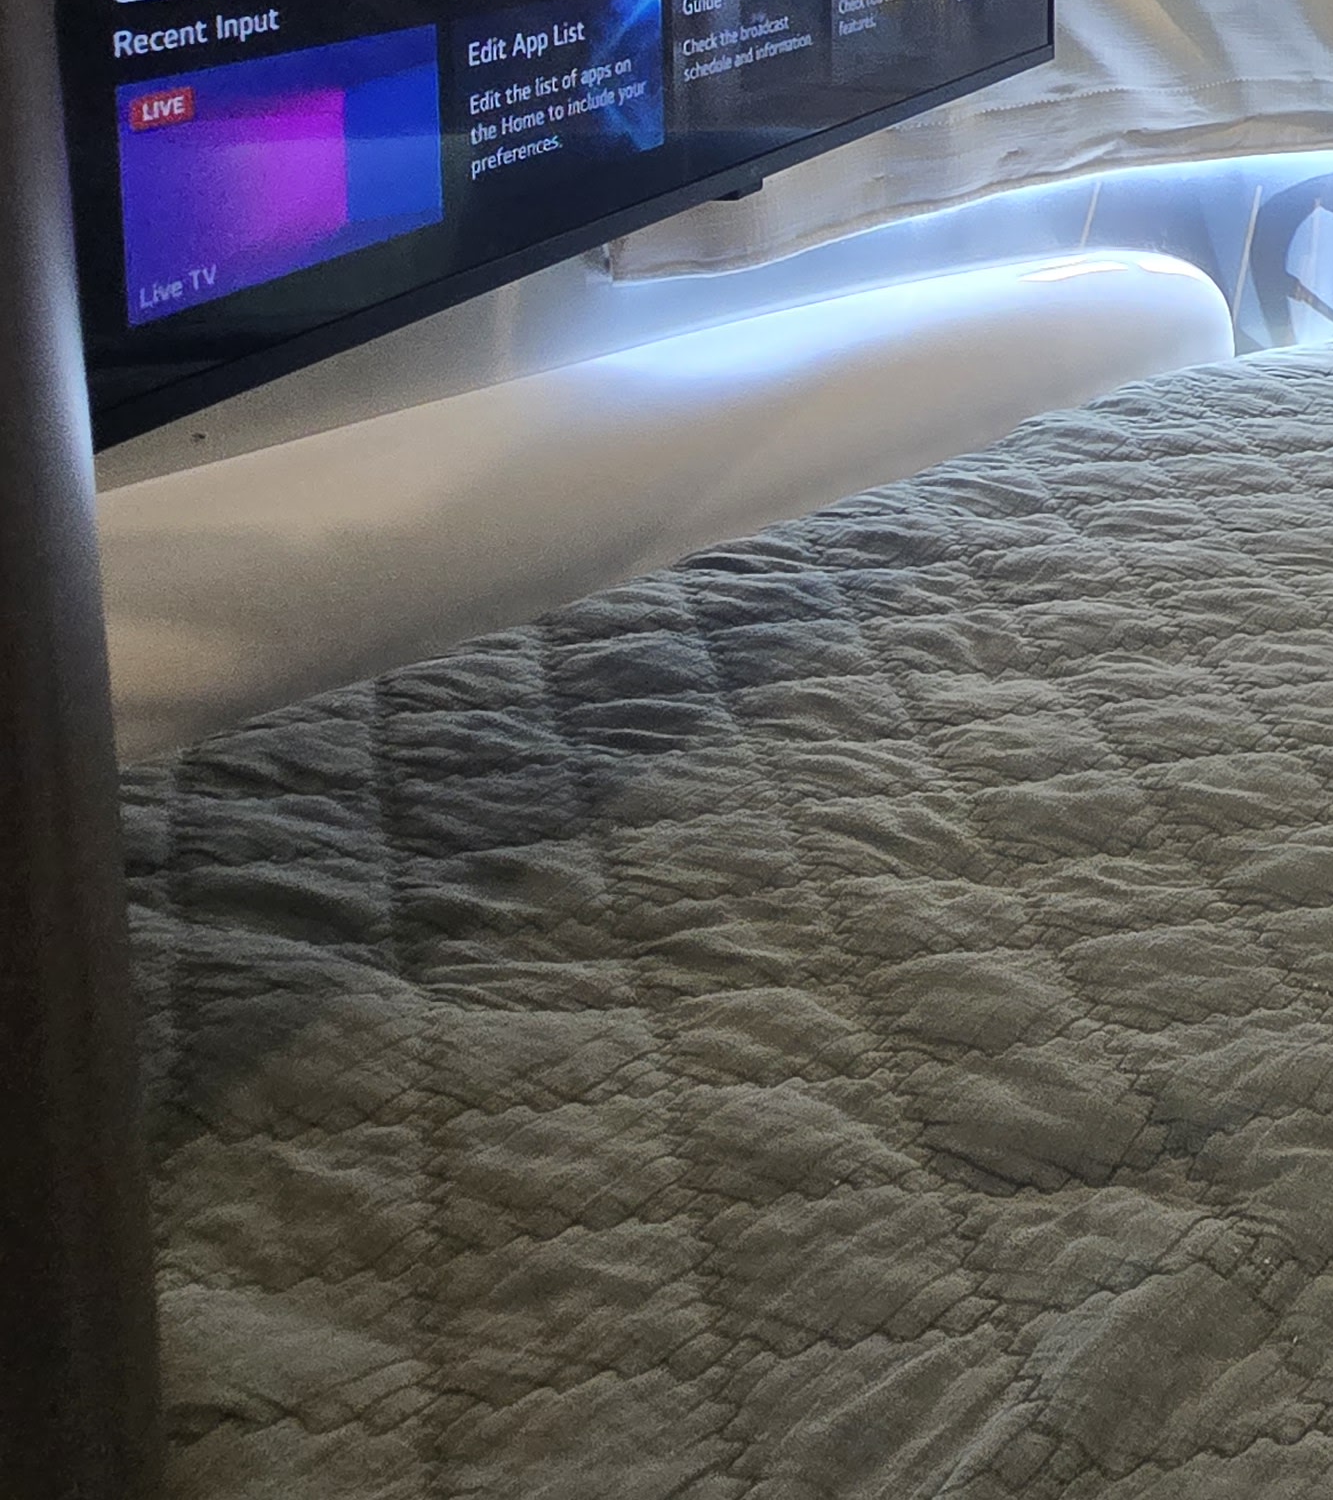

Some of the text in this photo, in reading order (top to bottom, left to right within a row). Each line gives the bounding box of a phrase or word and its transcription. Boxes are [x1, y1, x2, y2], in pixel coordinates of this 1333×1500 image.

[112, 8, 280, 58] Recent Input
[468, 21, 586, 66] Edit App List
[683, 16, 789, 56] Check the broadcast
[734, 47, 754, 67] and
[142, 95, 186, 122] LIVE
[470, 57, 632, 115] Edit the list of apps on
[470, 80, 648, 146] the Home to include your
[470, 134, 563, 180] preferences.
[138, 264, 217, 309] Live TV
